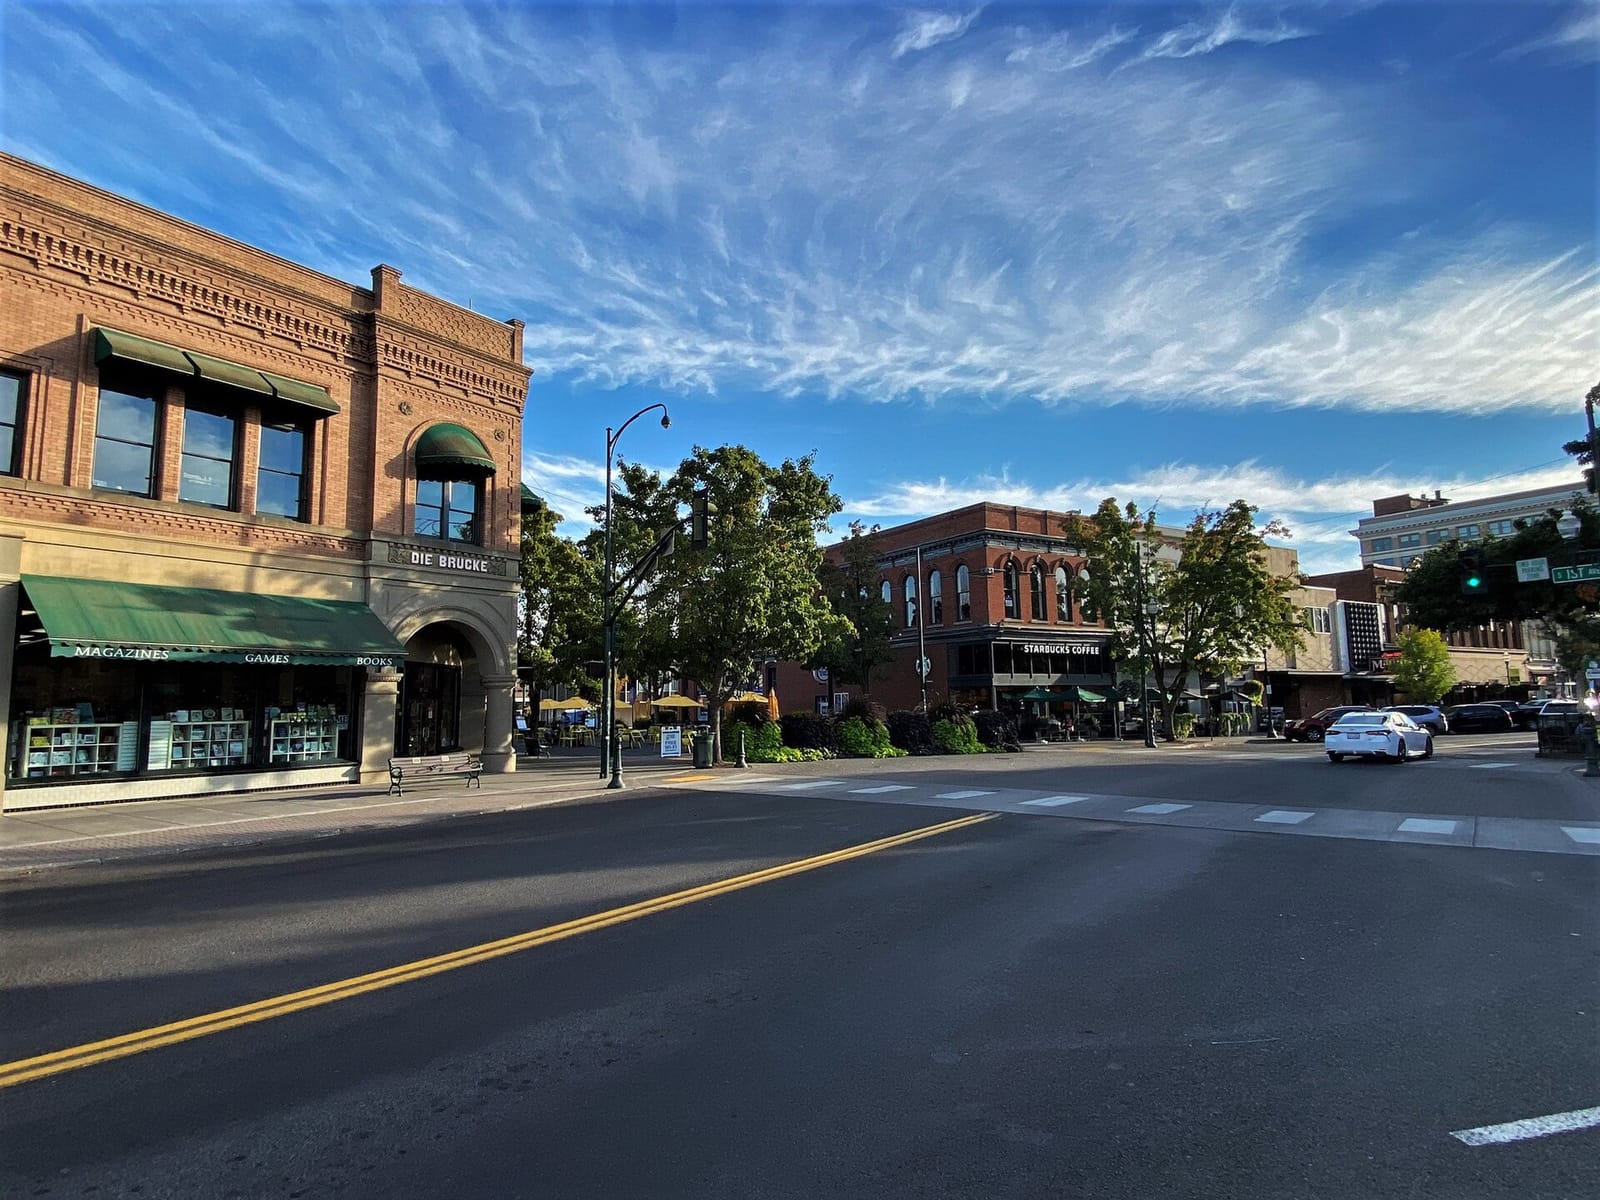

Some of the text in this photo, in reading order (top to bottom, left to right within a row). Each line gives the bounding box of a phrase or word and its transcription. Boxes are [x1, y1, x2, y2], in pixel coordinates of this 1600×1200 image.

[411, 551, 488, 572] DIE BRUCKE
[1566, 567, 1584, 579] 1ST
[74, 646, 169, 659] MAGAZINES
[1024, 644, 1100, 655] STARBUCKS COFFEE
[244, 653, 290, 664] GAMES
[356, 656, 393, 666] BOOKS
